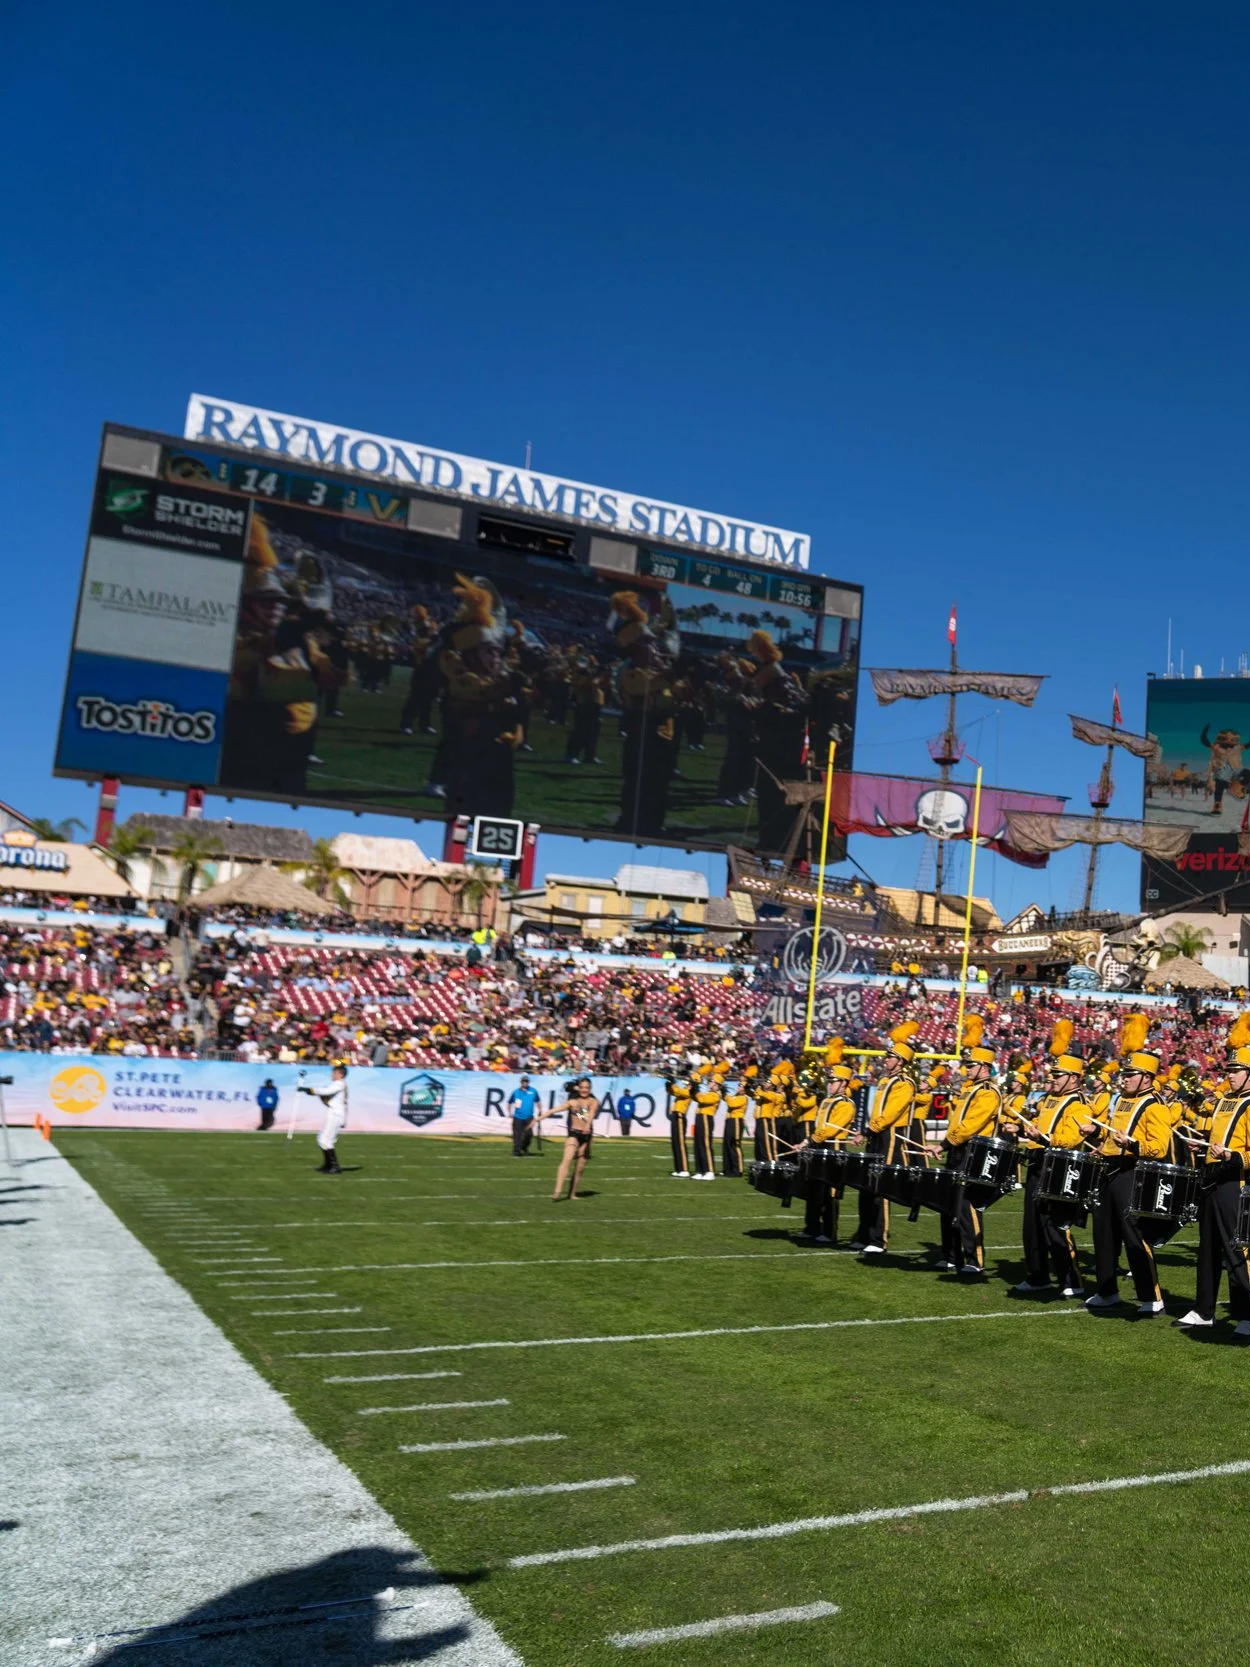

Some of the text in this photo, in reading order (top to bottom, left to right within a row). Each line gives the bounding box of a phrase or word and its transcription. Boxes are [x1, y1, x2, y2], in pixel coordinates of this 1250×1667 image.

[198, 401, 807, 569] RAYMOND JAMES STADIUM
[239, 468, 279, 497] 14
[307, 482, 328, 507] 3
[155, 494, 245, 526] STORM
[154, 510, 243, 536] SHIELDER
[651, 563, 676, 580] 3RD
[702, 574, 711, 587] 4
[736, 582, 753, 596] 48
[778, 590, 812, 608] 10:56
[481, 826, 514, 851] 25
[0, 845, 67, 869] orona
[981, 1150, 999, 1179] Pearl
[1063, 1164, 1080, 1195] Pearl
[1155, 1178, 1173, 1212] Pearl
